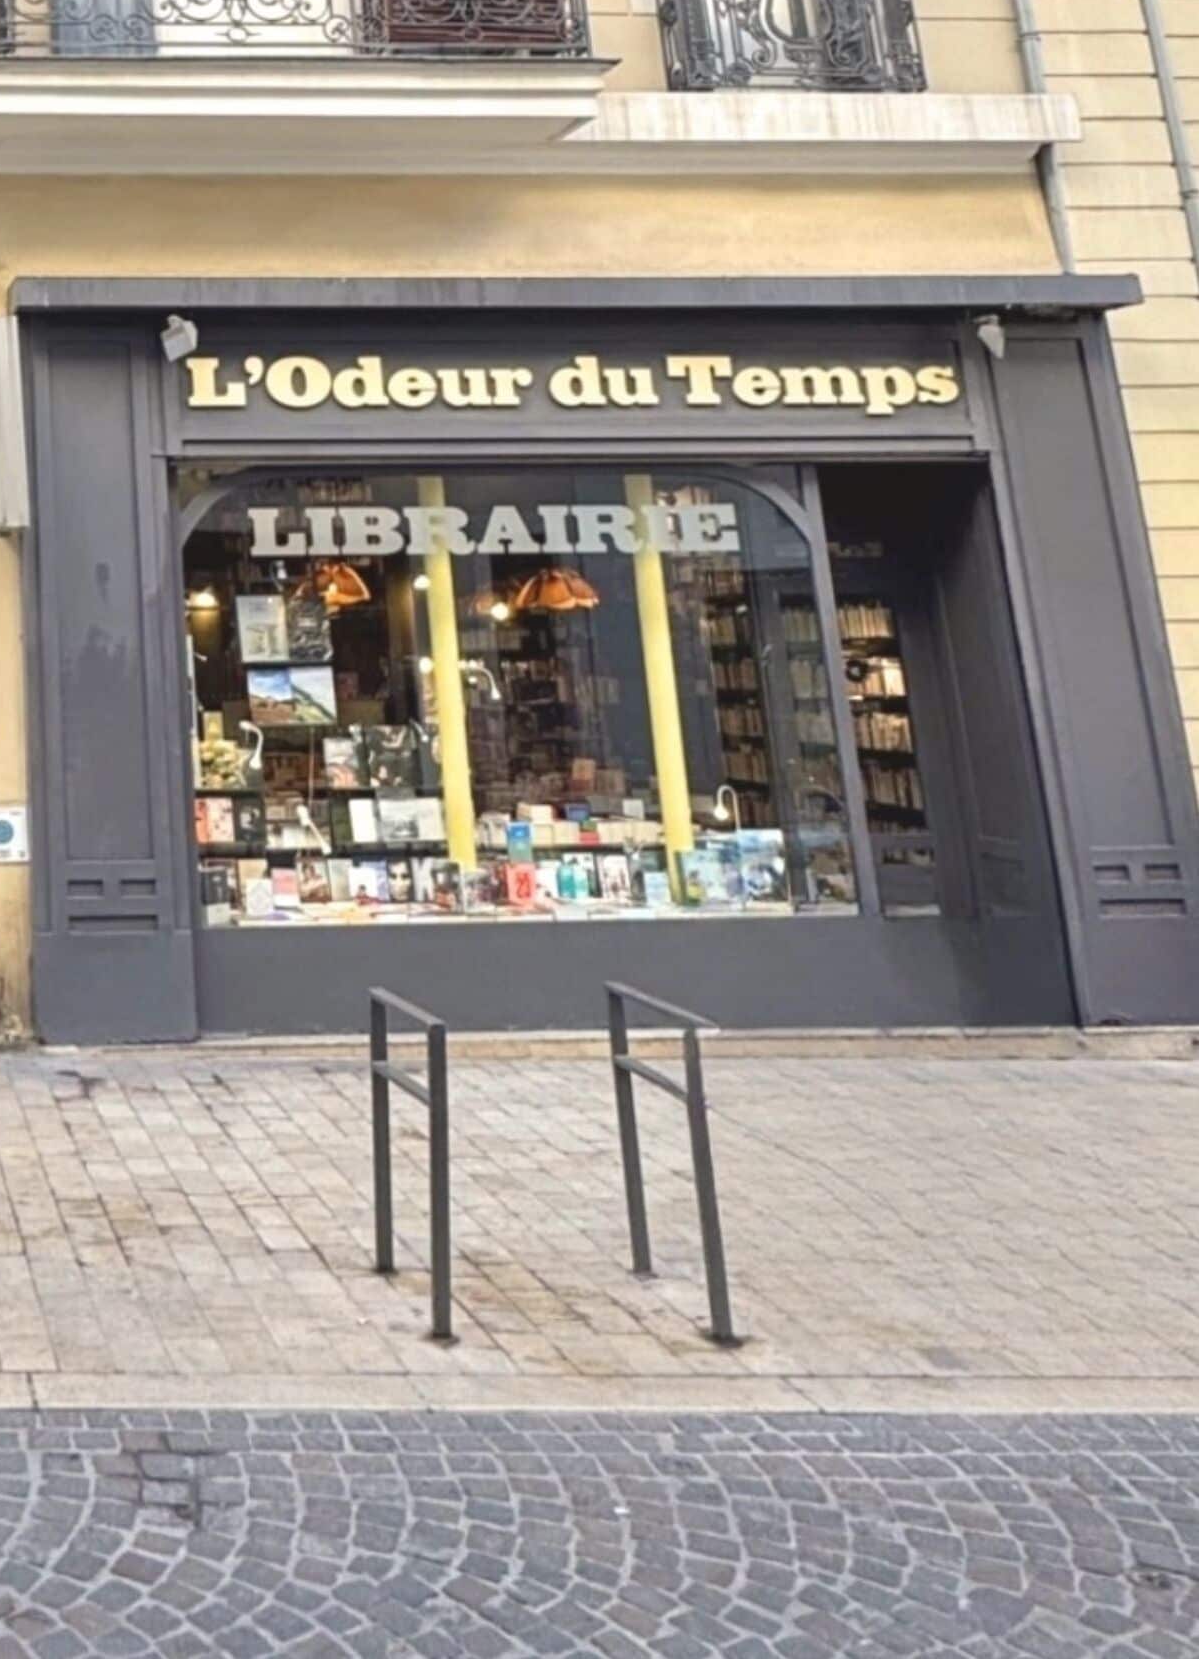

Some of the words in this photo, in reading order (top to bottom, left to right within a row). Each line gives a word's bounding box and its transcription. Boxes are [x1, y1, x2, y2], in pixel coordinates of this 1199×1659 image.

[186, 355, 534, 408] L'Odeur
[549, 355, 659, 408] du
[666, 355, 960, 416] Temps
[247, 503, 741, 557] LIBRAIRIE
